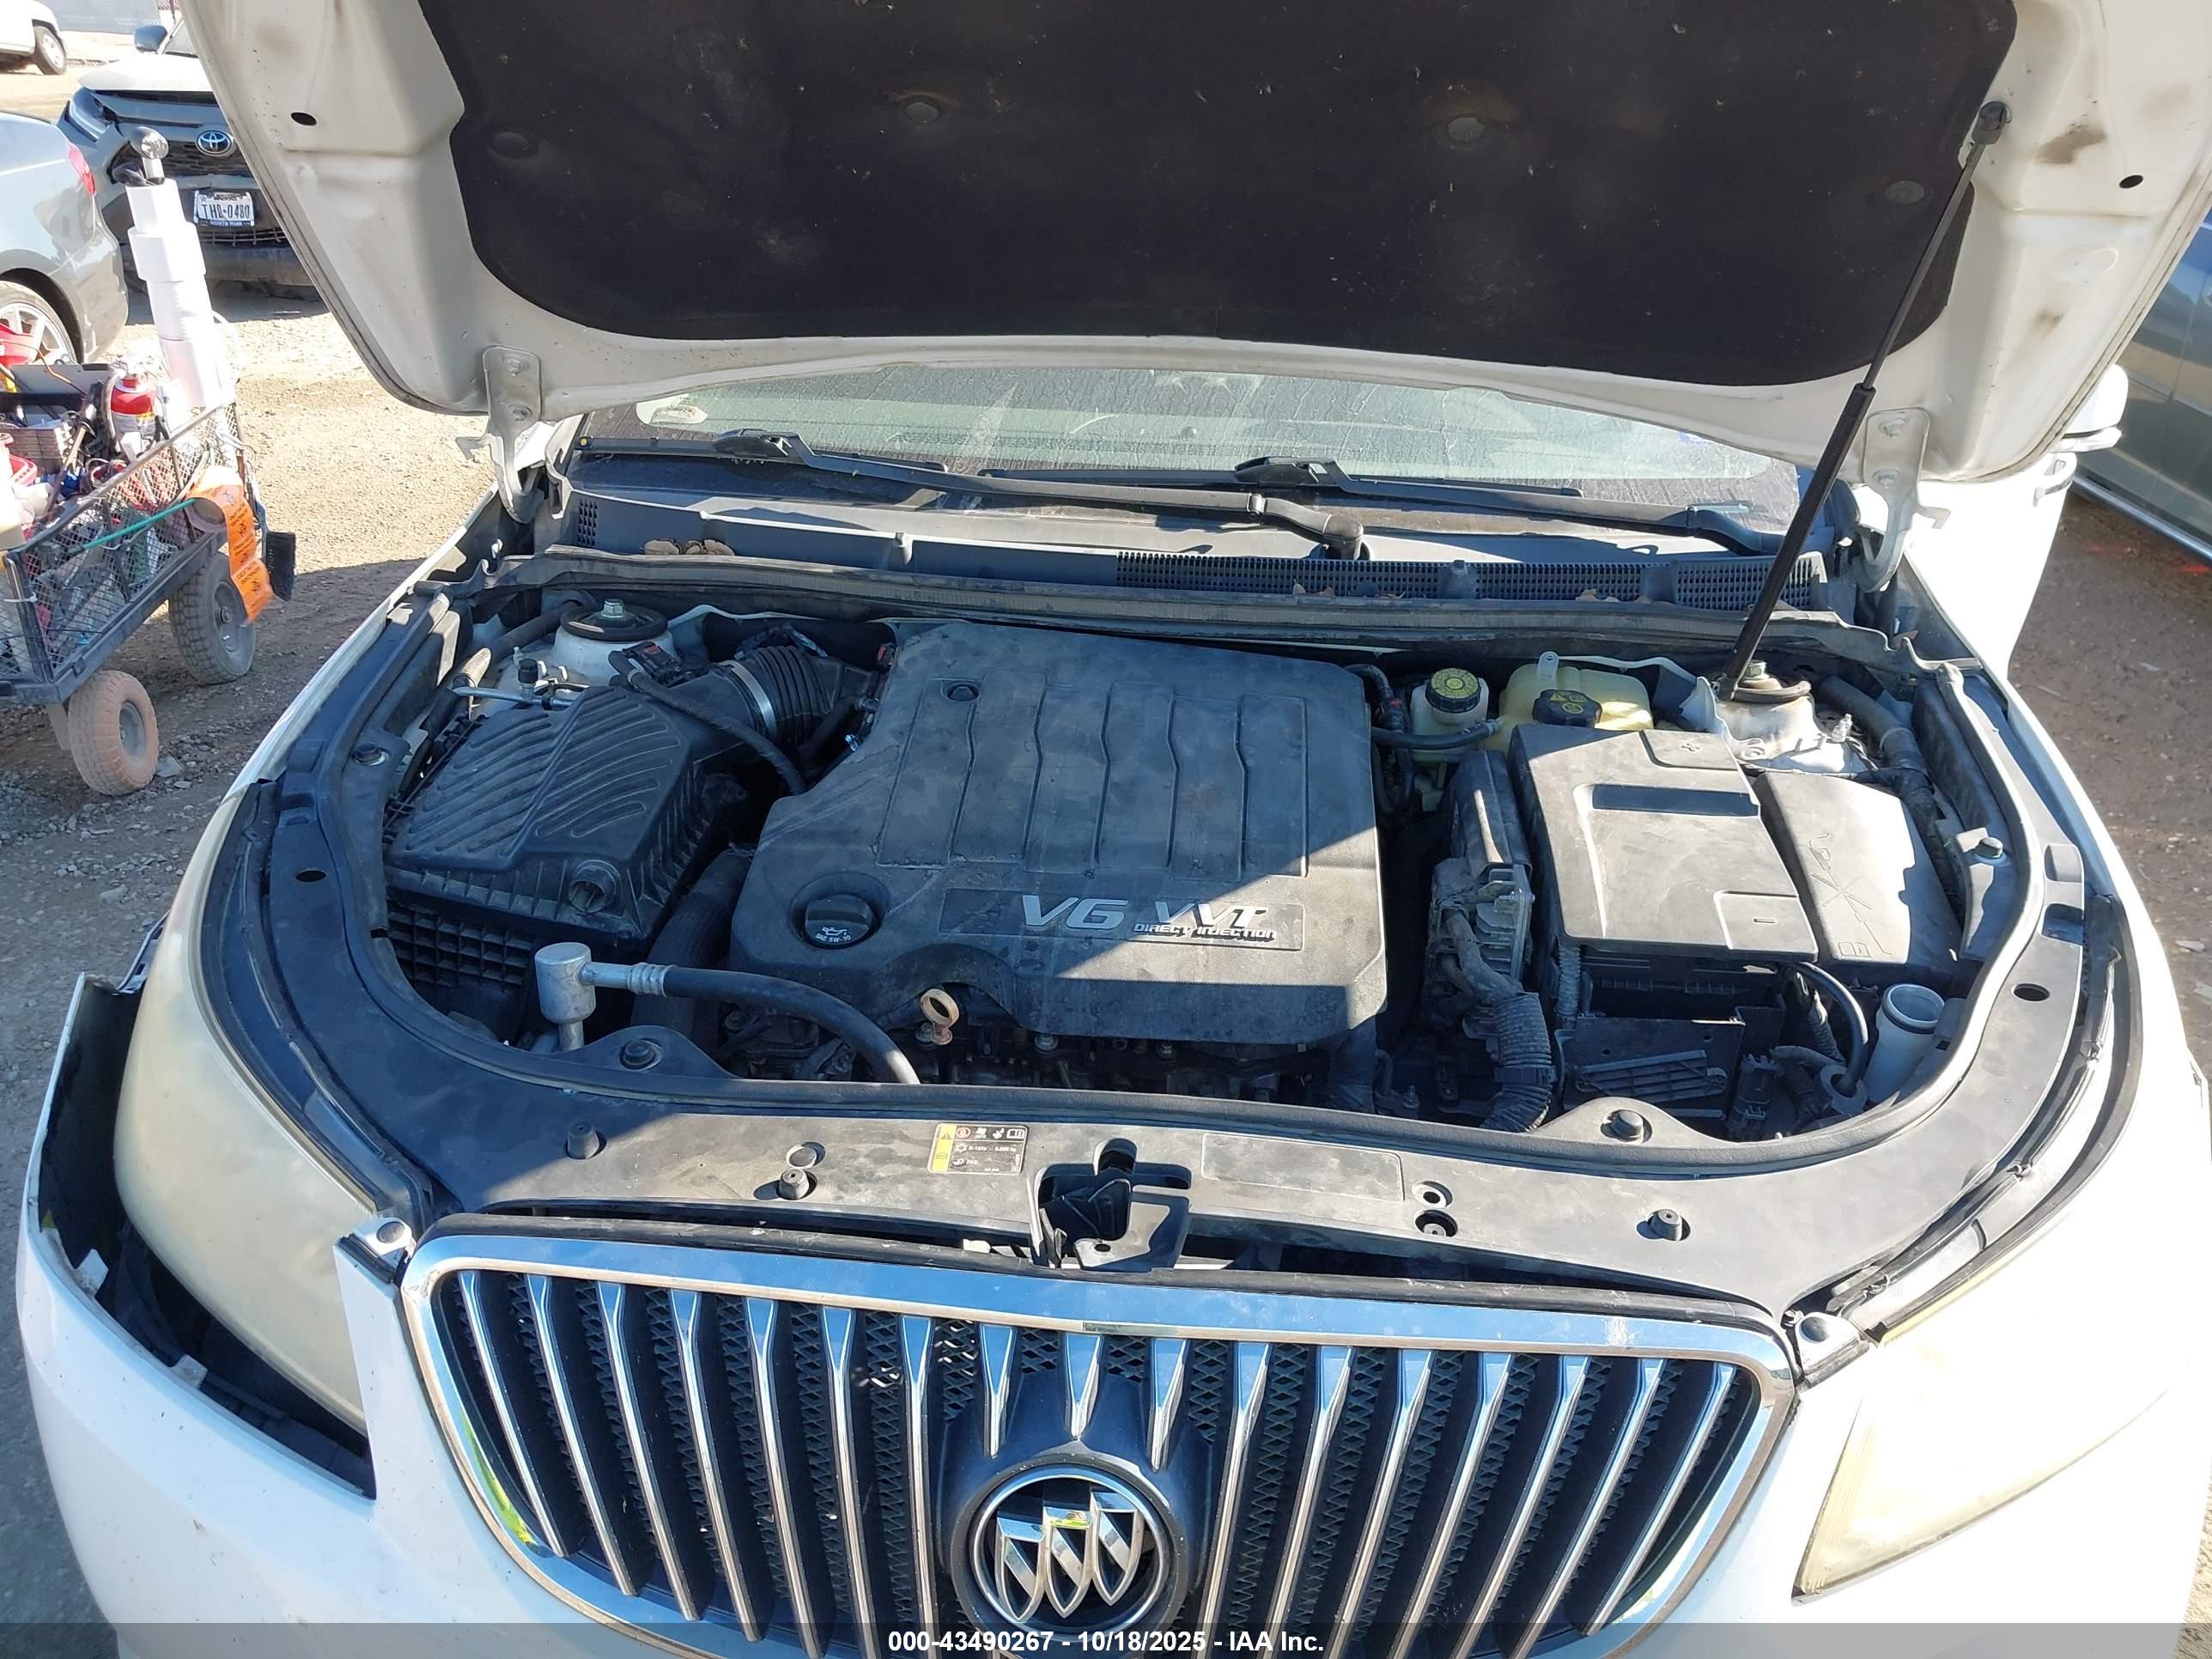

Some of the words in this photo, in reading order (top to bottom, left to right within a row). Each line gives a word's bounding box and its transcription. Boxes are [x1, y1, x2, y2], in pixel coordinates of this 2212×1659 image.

[1022, 894, 1128, 930] V6
[1154, 901, 1269, 928] VVT
[1133, 922, 1193, 935] DIRECT
[815, 933, 828, 941] SAE
